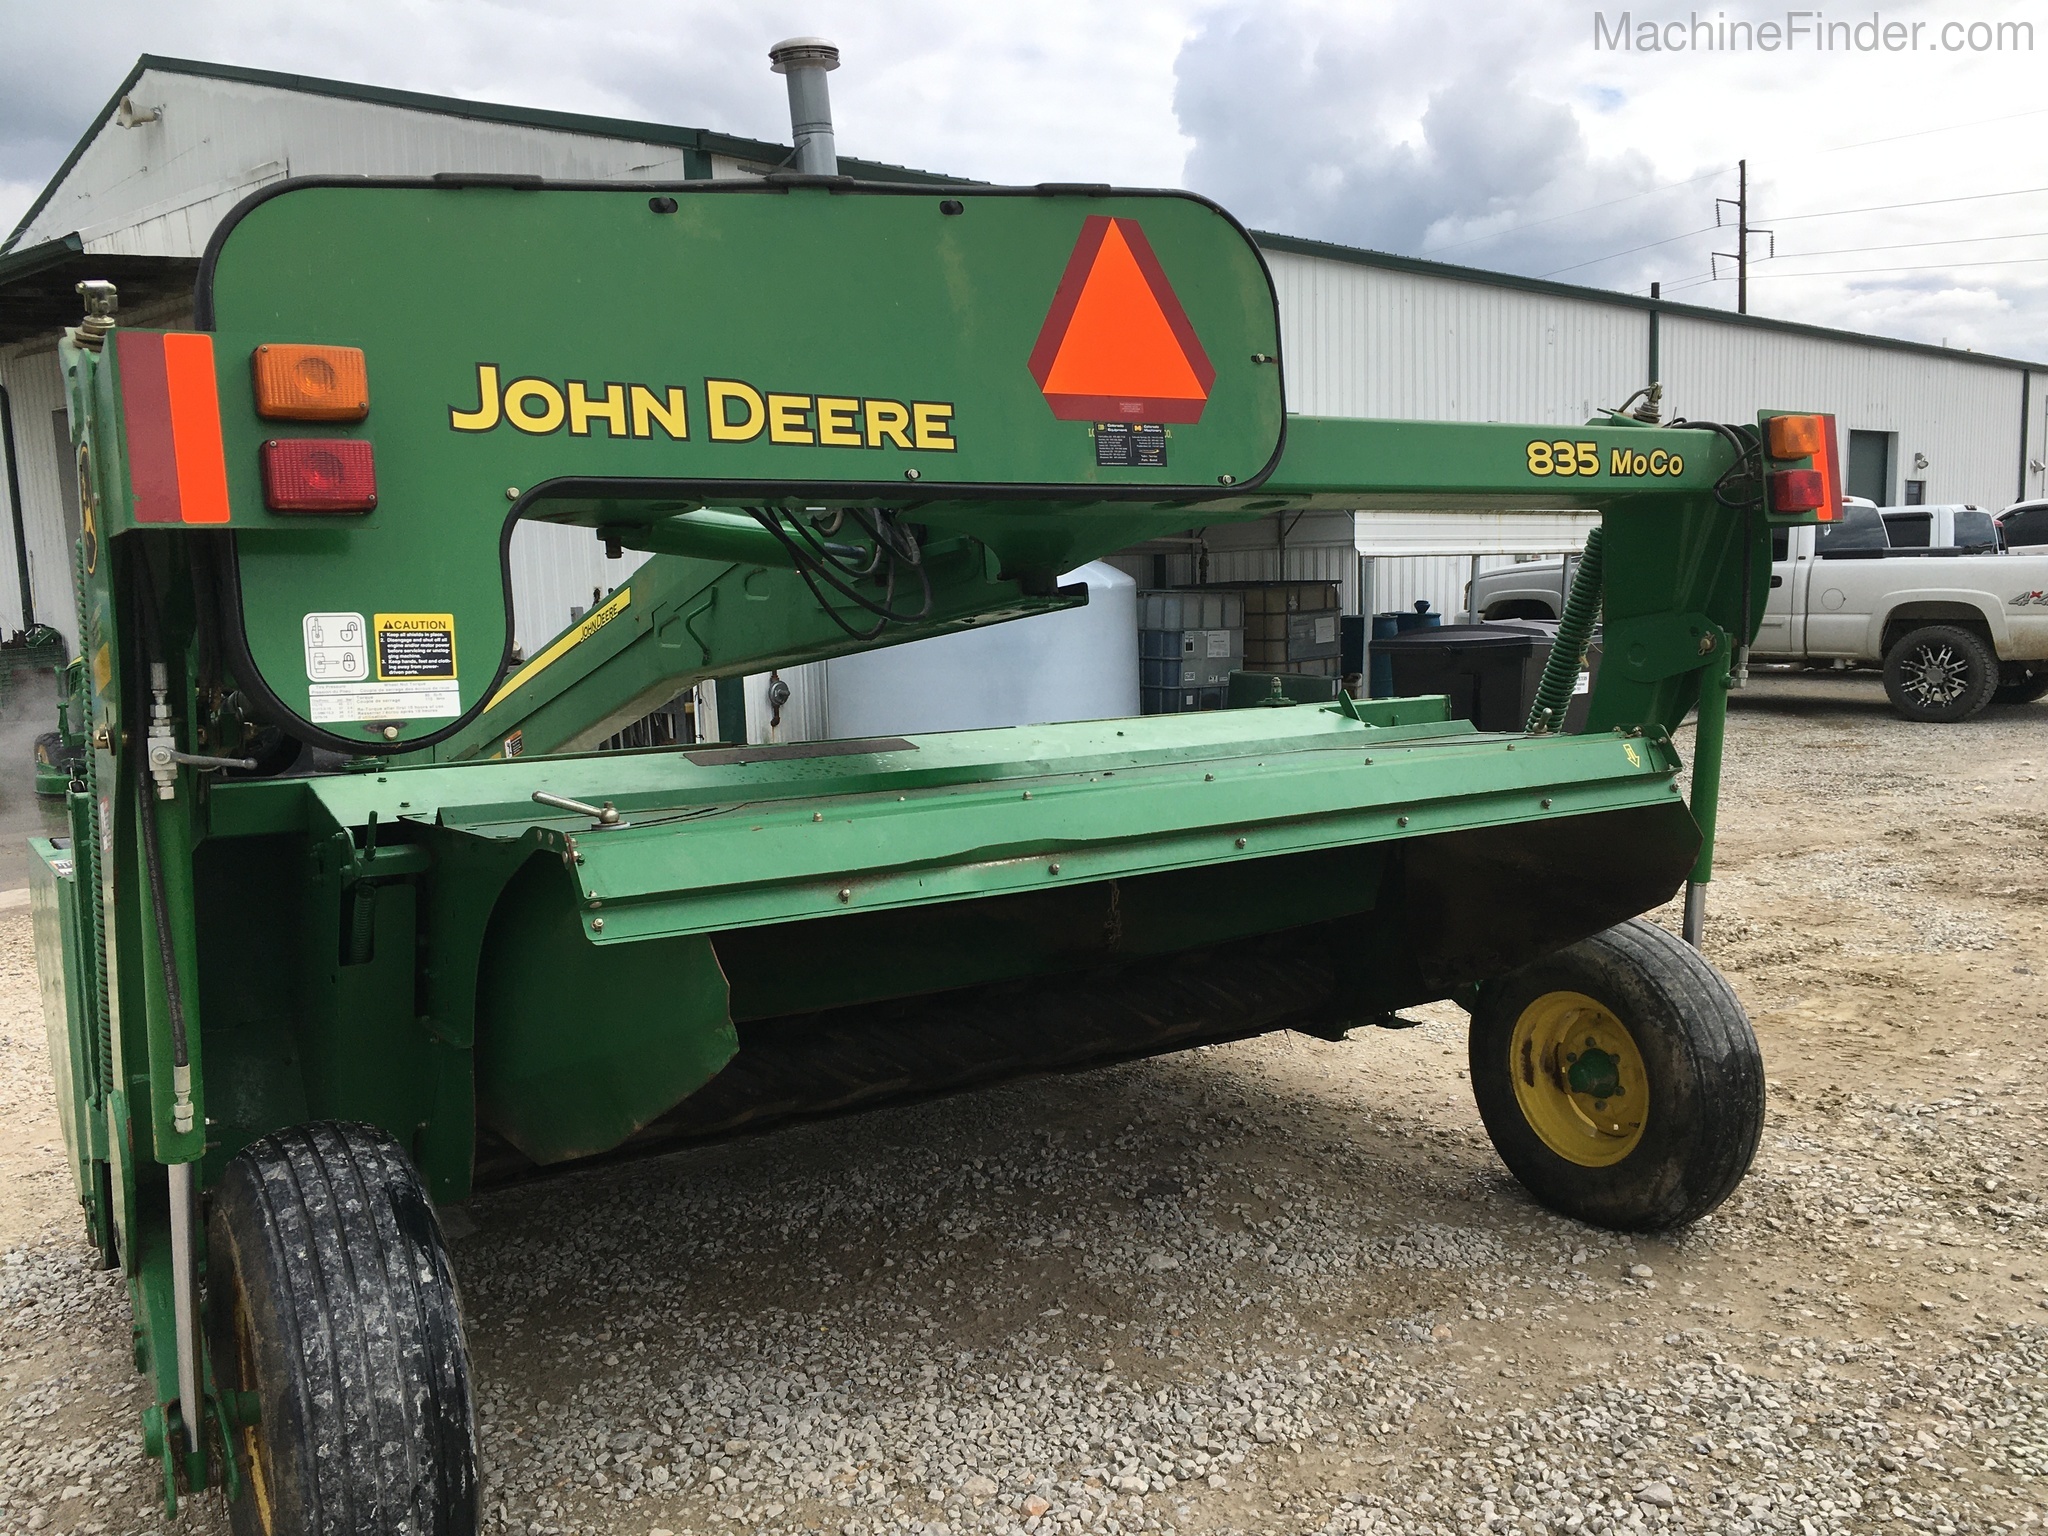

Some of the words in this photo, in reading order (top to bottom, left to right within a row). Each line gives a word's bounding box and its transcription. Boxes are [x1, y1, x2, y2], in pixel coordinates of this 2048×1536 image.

[450, 362, 690, 442] JOHN
[705, 376, 957, 453] DEERE
[1526, 439, 1600, 477] 835
[1610, 447, 1684, 477] MoCo
[394, 621, 446, 629] CAUTION
